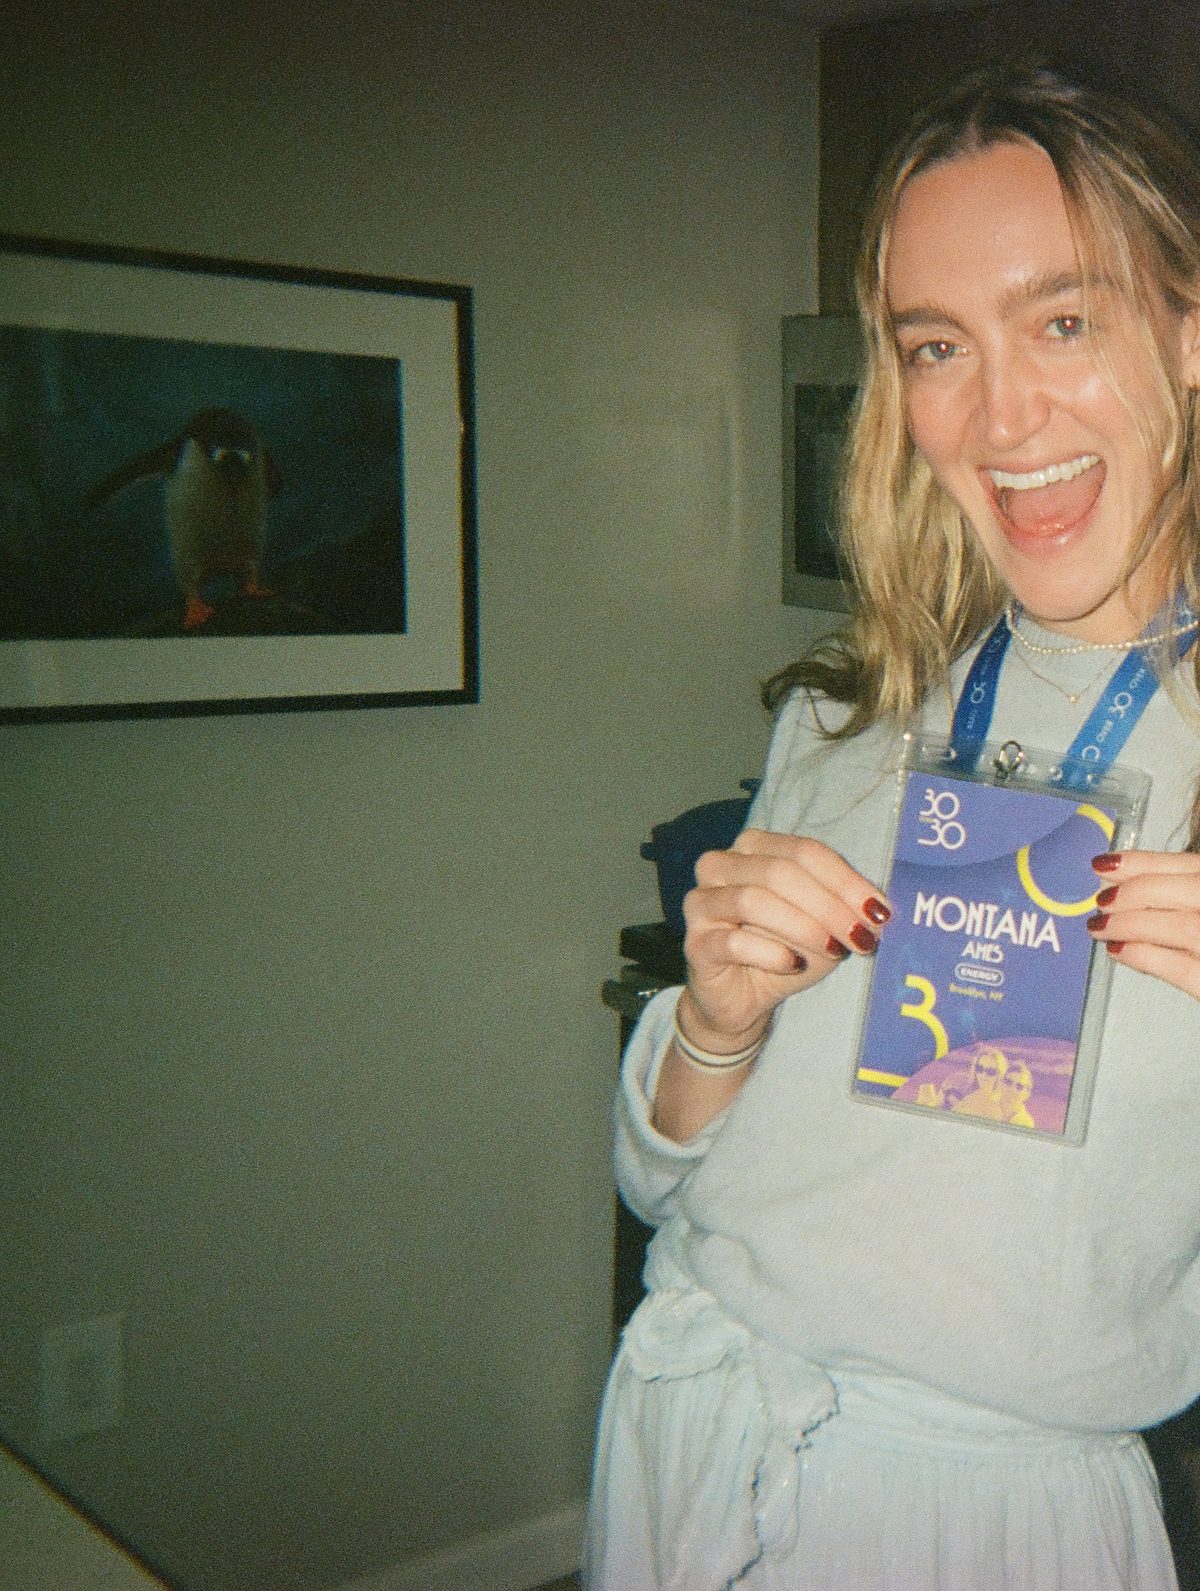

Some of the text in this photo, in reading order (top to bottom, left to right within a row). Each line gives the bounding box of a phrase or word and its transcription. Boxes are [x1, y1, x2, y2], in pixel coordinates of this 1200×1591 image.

[1107, 692, 1133, 719] 30
[919, 787, 961, 820] 30
[917, 818, 967, 851] 30
[912, 891, 1061, 953] MONTANA
[961, 940, 1005, 963] AMES
